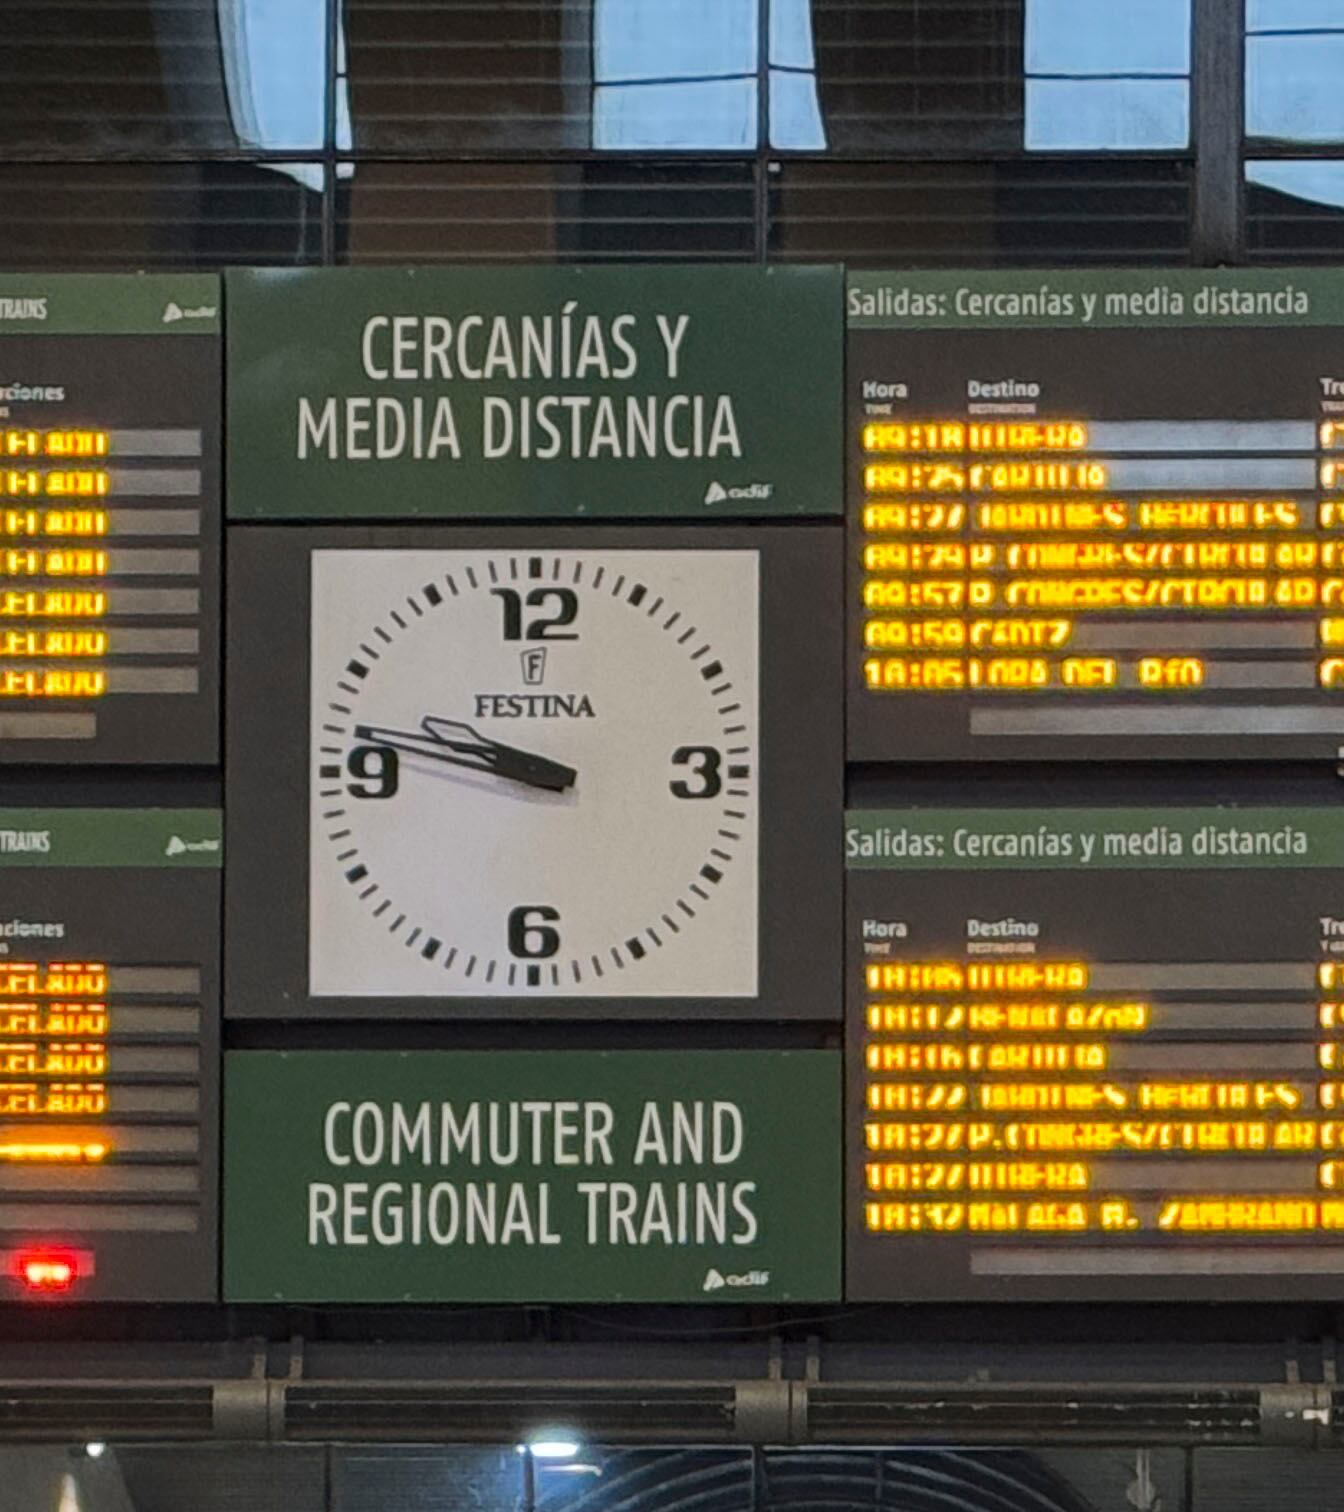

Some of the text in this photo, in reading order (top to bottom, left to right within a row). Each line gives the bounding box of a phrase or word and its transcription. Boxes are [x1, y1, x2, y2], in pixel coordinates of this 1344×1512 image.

[848, 286, 1308, 322] Salidas: Cercanías y media distancia
[363, 302, 688, 379] CERCANÍAS Y
[863, 380, 1039, 398] Hora Destino
[298, 395, 741, 459] MEDIA DISTANCIA
[490, 587, 580, 641] 12
[475, 694, 595, 718] FESTINA
[348, 746, 722, 799] 9 3
[847, 826, 1307, 862] Salidas: Cercanías y media distancia
[508, 906, 560, 959] 6
[863, 919, 1038, 937] Hora Destino
[325, 1102, 742, 1165] COMMUTER AND
[310, 1182, 757, 1245] REGIONAL TRAINS
